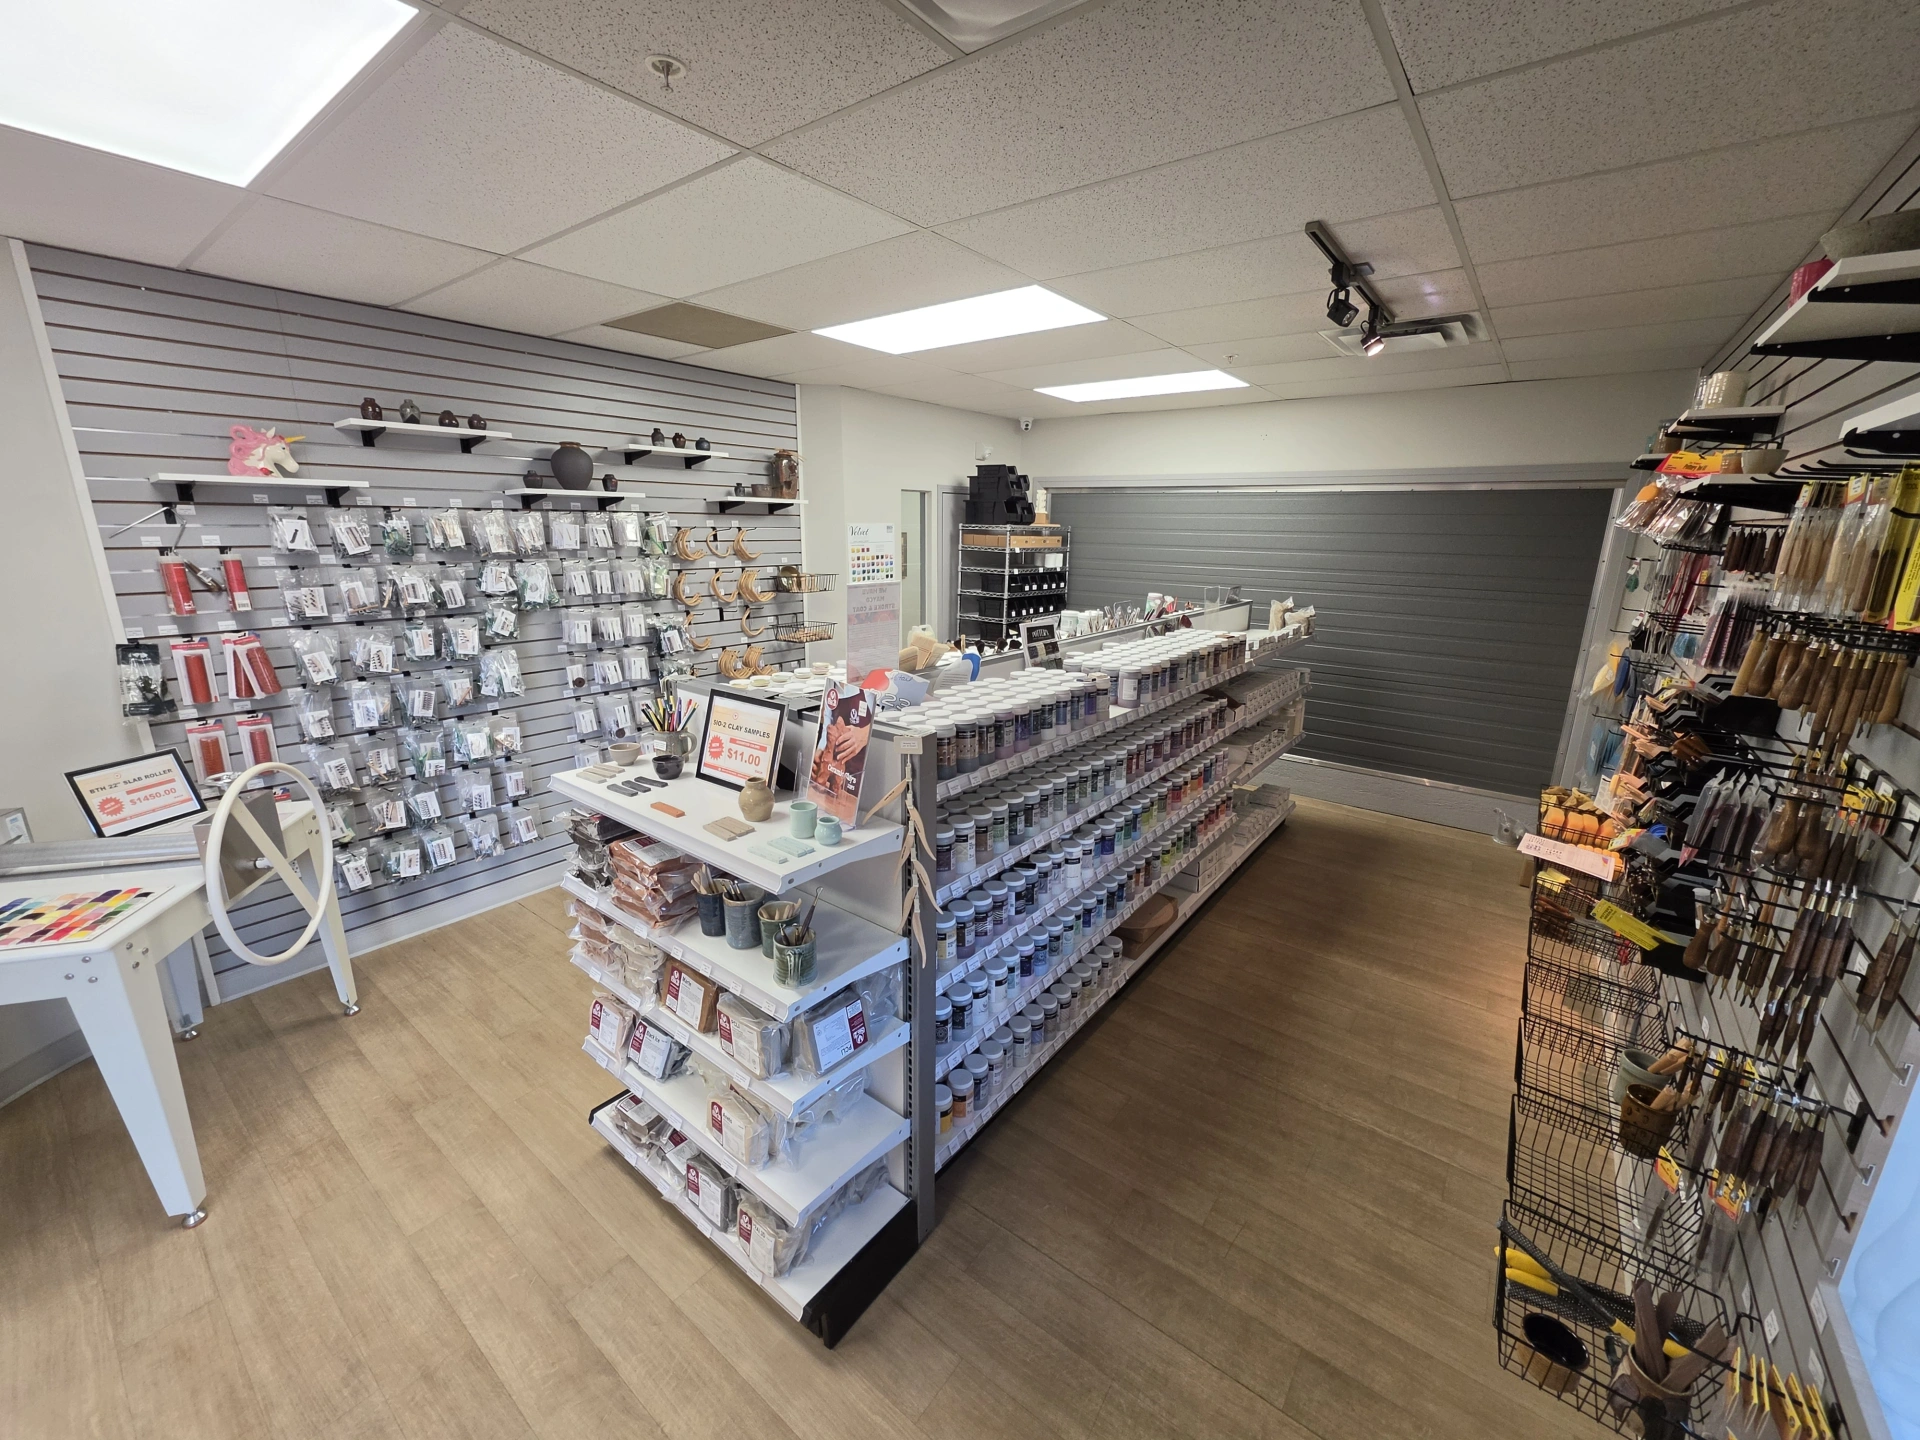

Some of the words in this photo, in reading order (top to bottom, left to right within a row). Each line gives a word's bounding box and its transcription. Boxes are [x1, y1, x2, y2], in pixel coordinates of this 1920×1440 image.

[850, 525, 870, 536] Velvet
[728, 723, 743, 732] CLAY
[744, 727, 771, 739] SAMPLES
[727, 748, 761, 767] $11.00
[89, 786, 106, 794] BTH
[122, 776, 143, 785] SLAB
[144, 768, 173, 779] ROLLER
[129, 787, 177, 806] $1450.00
